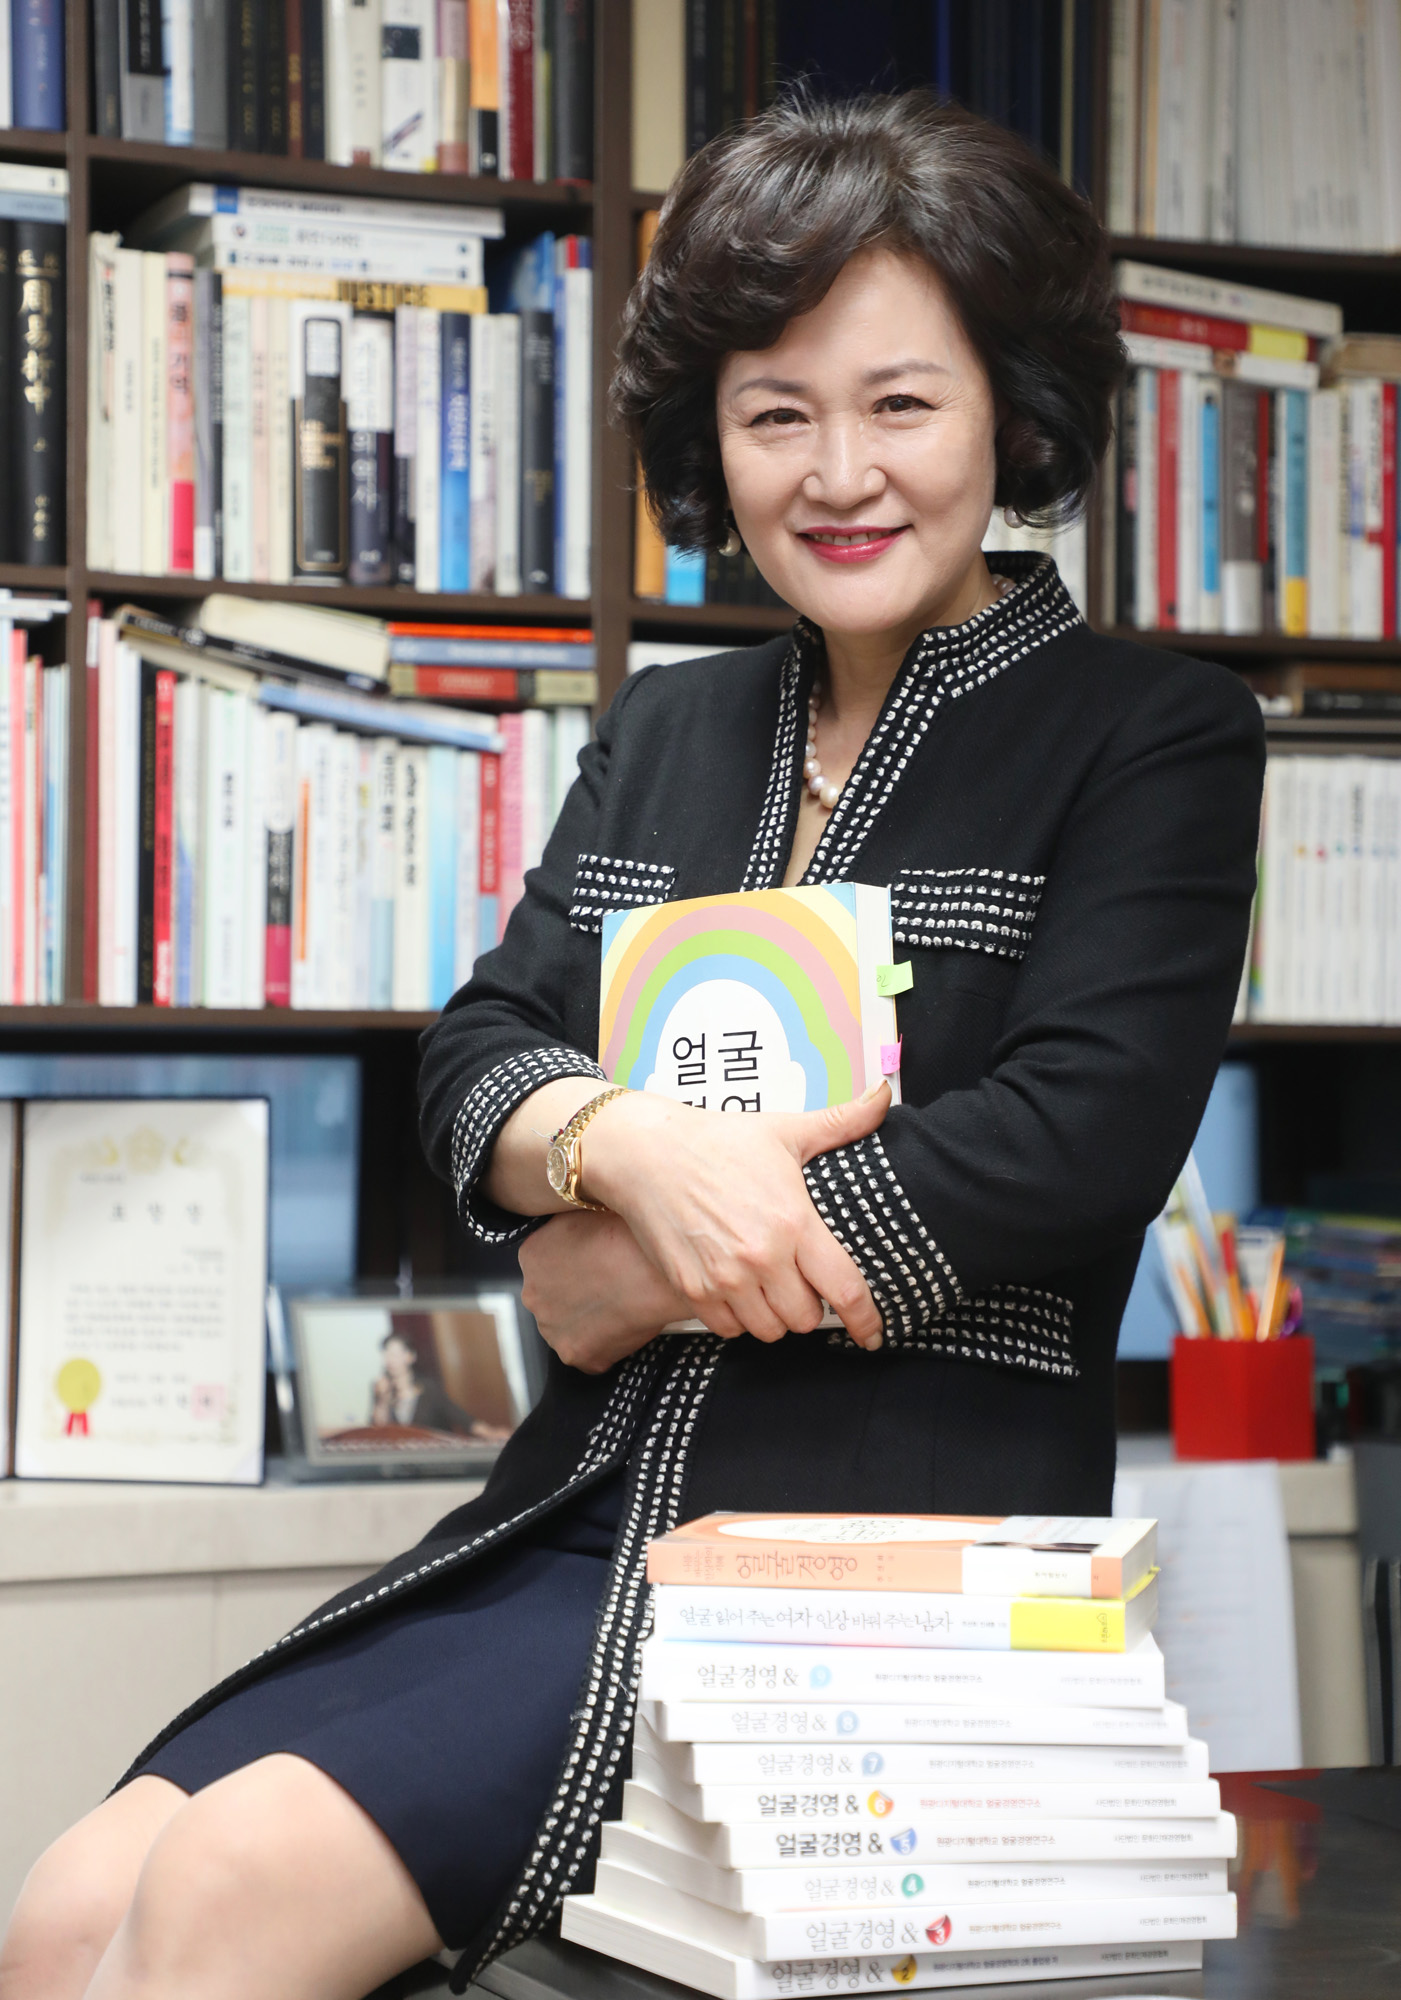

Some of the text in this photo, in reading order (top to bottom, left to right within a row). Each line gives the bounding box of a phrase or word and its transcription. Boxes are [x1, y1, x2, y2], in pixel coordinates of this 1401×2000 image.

[673, 1030, 763, 1086] 얼굴
[736, 1551, 858, 1581] 얼굴경영
[680, 1606, 954, 1634] 얼굴 읽어 주는 여자 인상 바꿔 주는 남자
[699, 1665, 778, 1690] 얼굴경영
[783, 1668, 799, 1688] &
[731, 1711, 809, 1736] 얼굴경영
[812, 1715, 828, 1733] &
[758, 1752, 836, 1777] 얼굴경영
[839, 1756, 854, 1775] &
[758, 1794, 840, 1818] 얼굴경영
[845, 1794, 861, 1816] &
[776, 1832, 863, 1859] 얼굴경영
[868, 1832, 885, 1856] &
[804, 1876, 878, 1901] 얼굴경영
[882, 1880, 896, 1898] &
[806, 1919, 897, 1954] 얼굴경영
[901, 1923, 919, 1945] &
[771, 1958, 862, 1994] 얼굴경영
[866, 1960, 884, 1985] &
